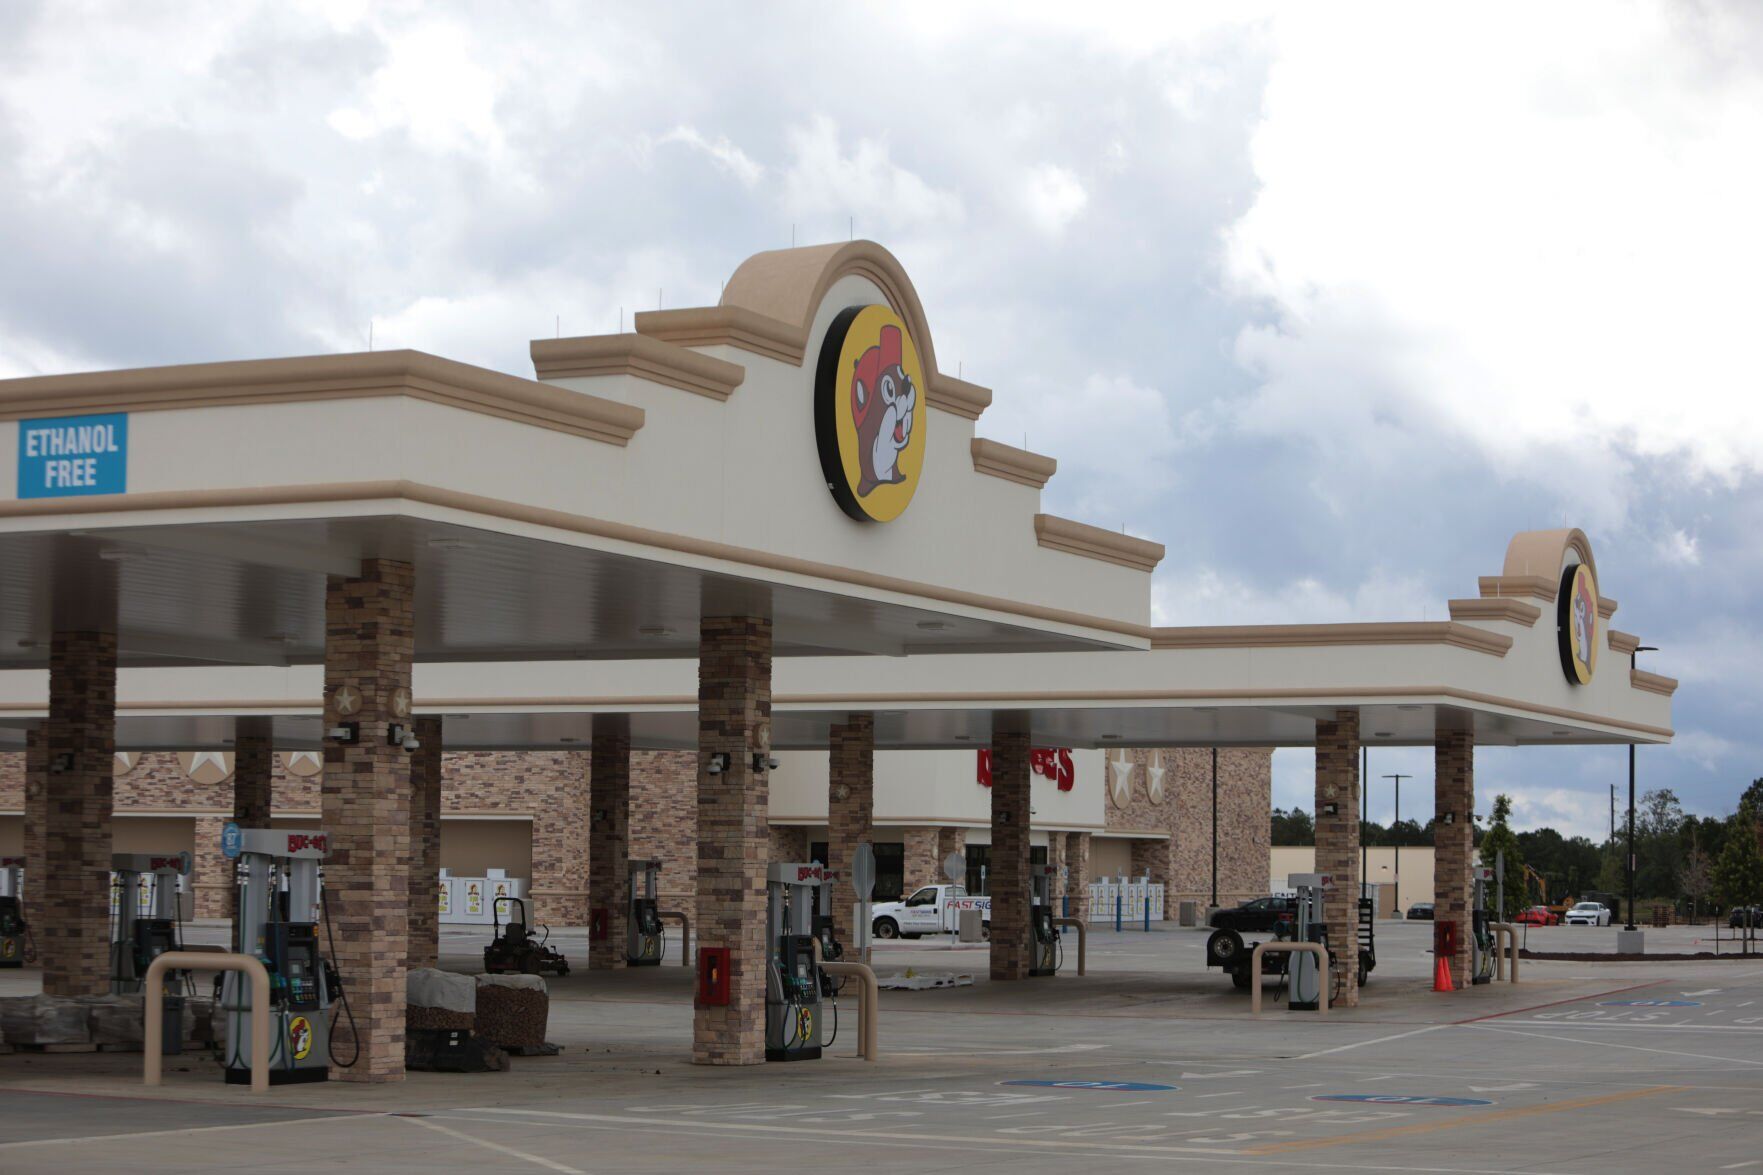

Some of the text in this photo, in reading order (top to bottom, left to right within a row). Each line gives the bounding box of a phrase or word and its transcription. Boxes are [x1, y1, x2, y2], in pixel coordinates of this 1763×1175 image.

[26, 424, 118, 457] ETHANOL
[45, 458, 97, 488] FREE
[1533, 1010, 1672, 1022] STOP
[820, 1089, 1074, 1107] WEST
[623, 1102, 925, 1123] STOP
[1161, 1105, 1415, 1123] EAST
[993, 1122, 1296, 1143] STOP
